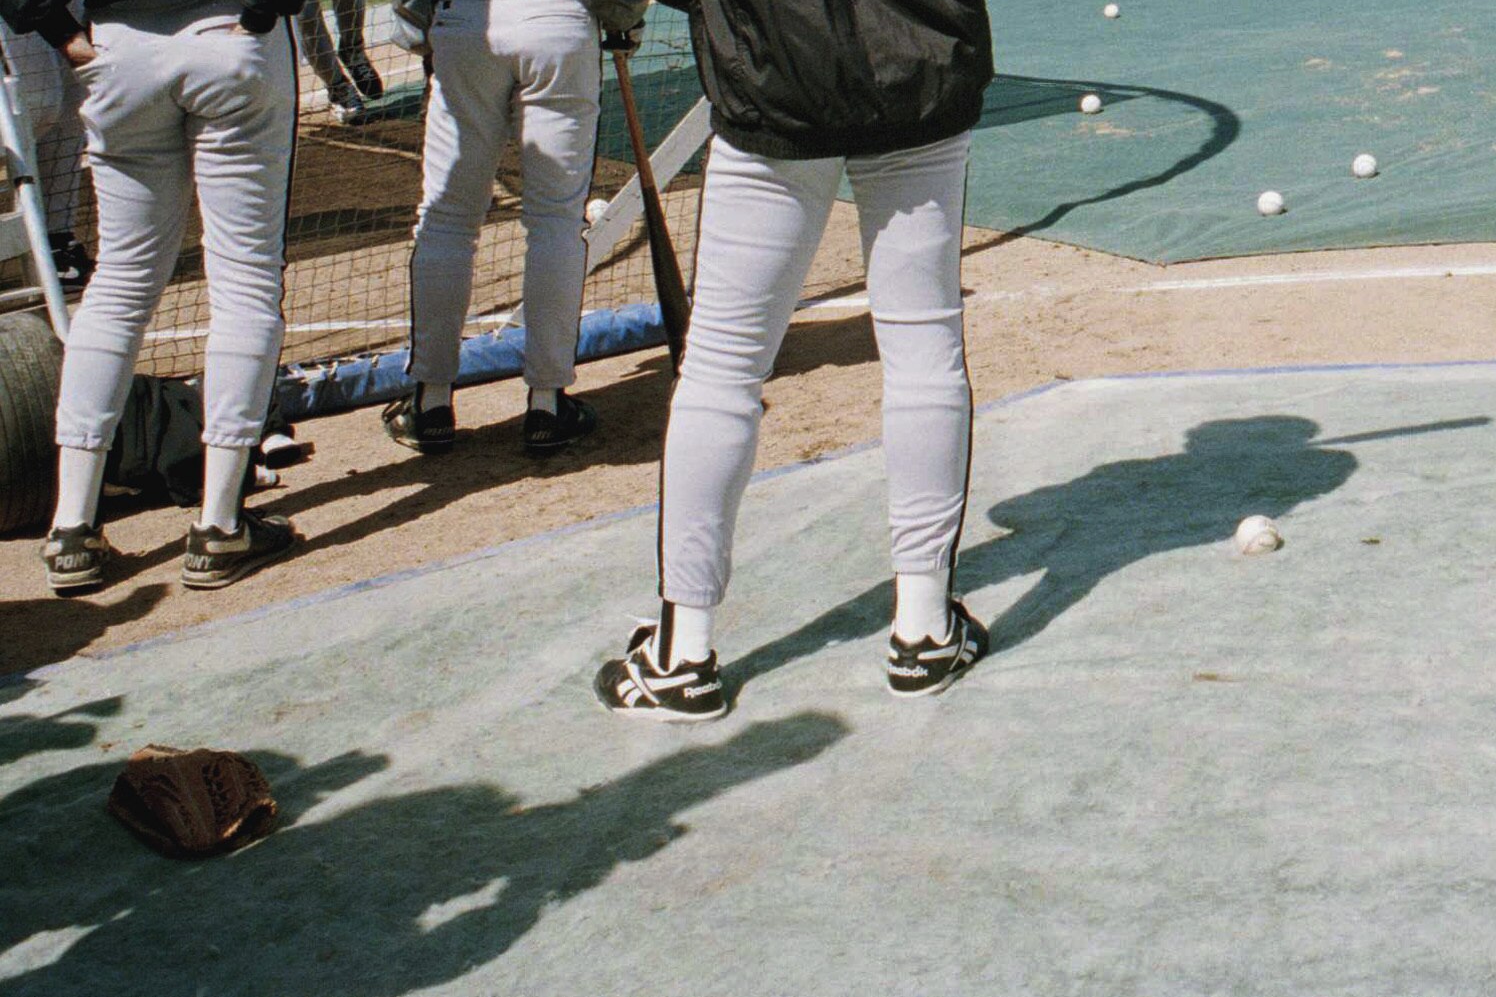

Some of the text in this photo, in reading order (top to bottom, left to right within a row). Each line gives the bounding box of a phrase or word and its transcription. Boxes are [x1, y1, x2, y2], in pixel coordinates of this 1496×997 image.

[54, 553, 91, 570] PONY
[186, 554, 213, 570] ONY
[683, 678, 722, 699] Reebo
